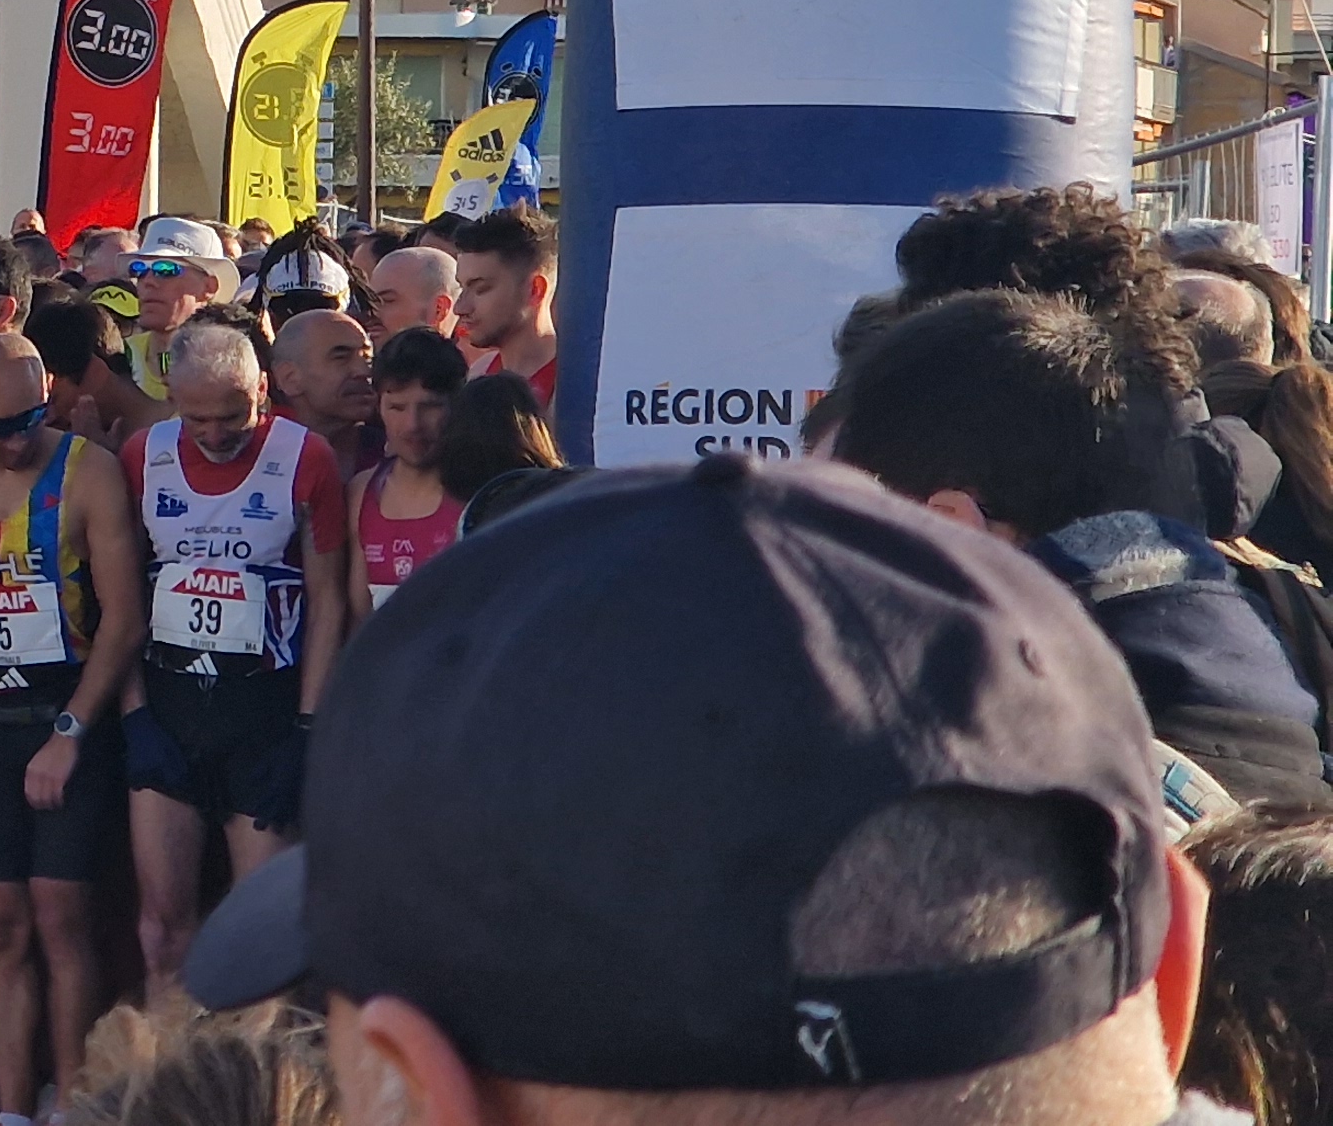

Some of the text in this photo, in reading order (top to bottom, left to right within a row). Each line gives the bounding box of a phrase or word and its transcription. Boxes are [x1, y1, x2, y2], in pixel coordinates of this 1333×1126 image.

[75, 7, 151, 61] 3.00
[64, 111, 135, 156] 3.00
[458, 147, 505, 163] adidas
[625, 380, 793, 426] RÉGION
[176, 539, 253, 560] CELIO
[184, 573, 244, 596] MAIF
[188, 597, 223, 636] 39
